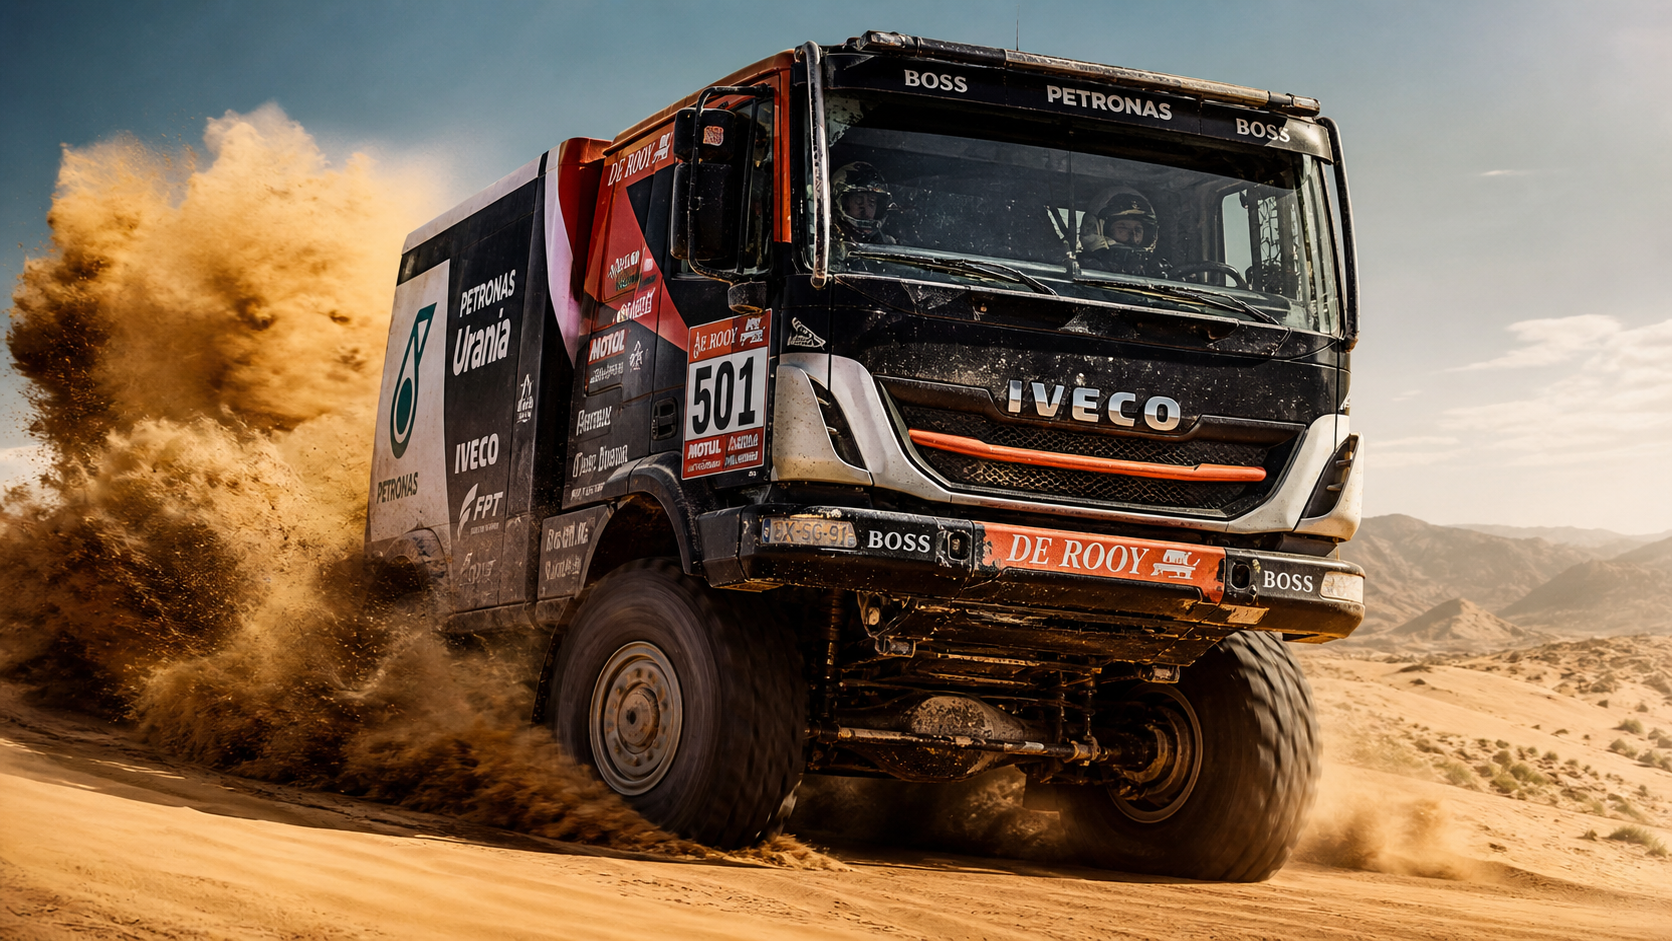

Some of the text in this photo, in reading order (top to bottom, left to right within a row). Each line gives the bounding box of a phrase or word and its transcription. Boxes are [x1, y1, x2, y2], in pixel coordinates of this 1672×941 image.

[904, 69, 968, 93] BOSS
[1046, 85, 1173, 121] PETRONAS
[1236, 117, 1291, 143] BOSS
[607, 141, 656, 187] DE ROOY
[459, 269, 517, 318] PETRONAS
[692, 355, 756, 435] 501
[1008, 379, 1182, 432] IVECO
[454, 432, 500, 475] IVECO
[687, 439, 722, 460] MOTUL
[376, 471, 419, 505] PETRONAS
[473, 491, 504, 521] FPT
[867, 530, 932, 554] BOSS
[1006, 533, 1150, 575] DE ROOY
[1262, 570, 1314, 593] BOSS
